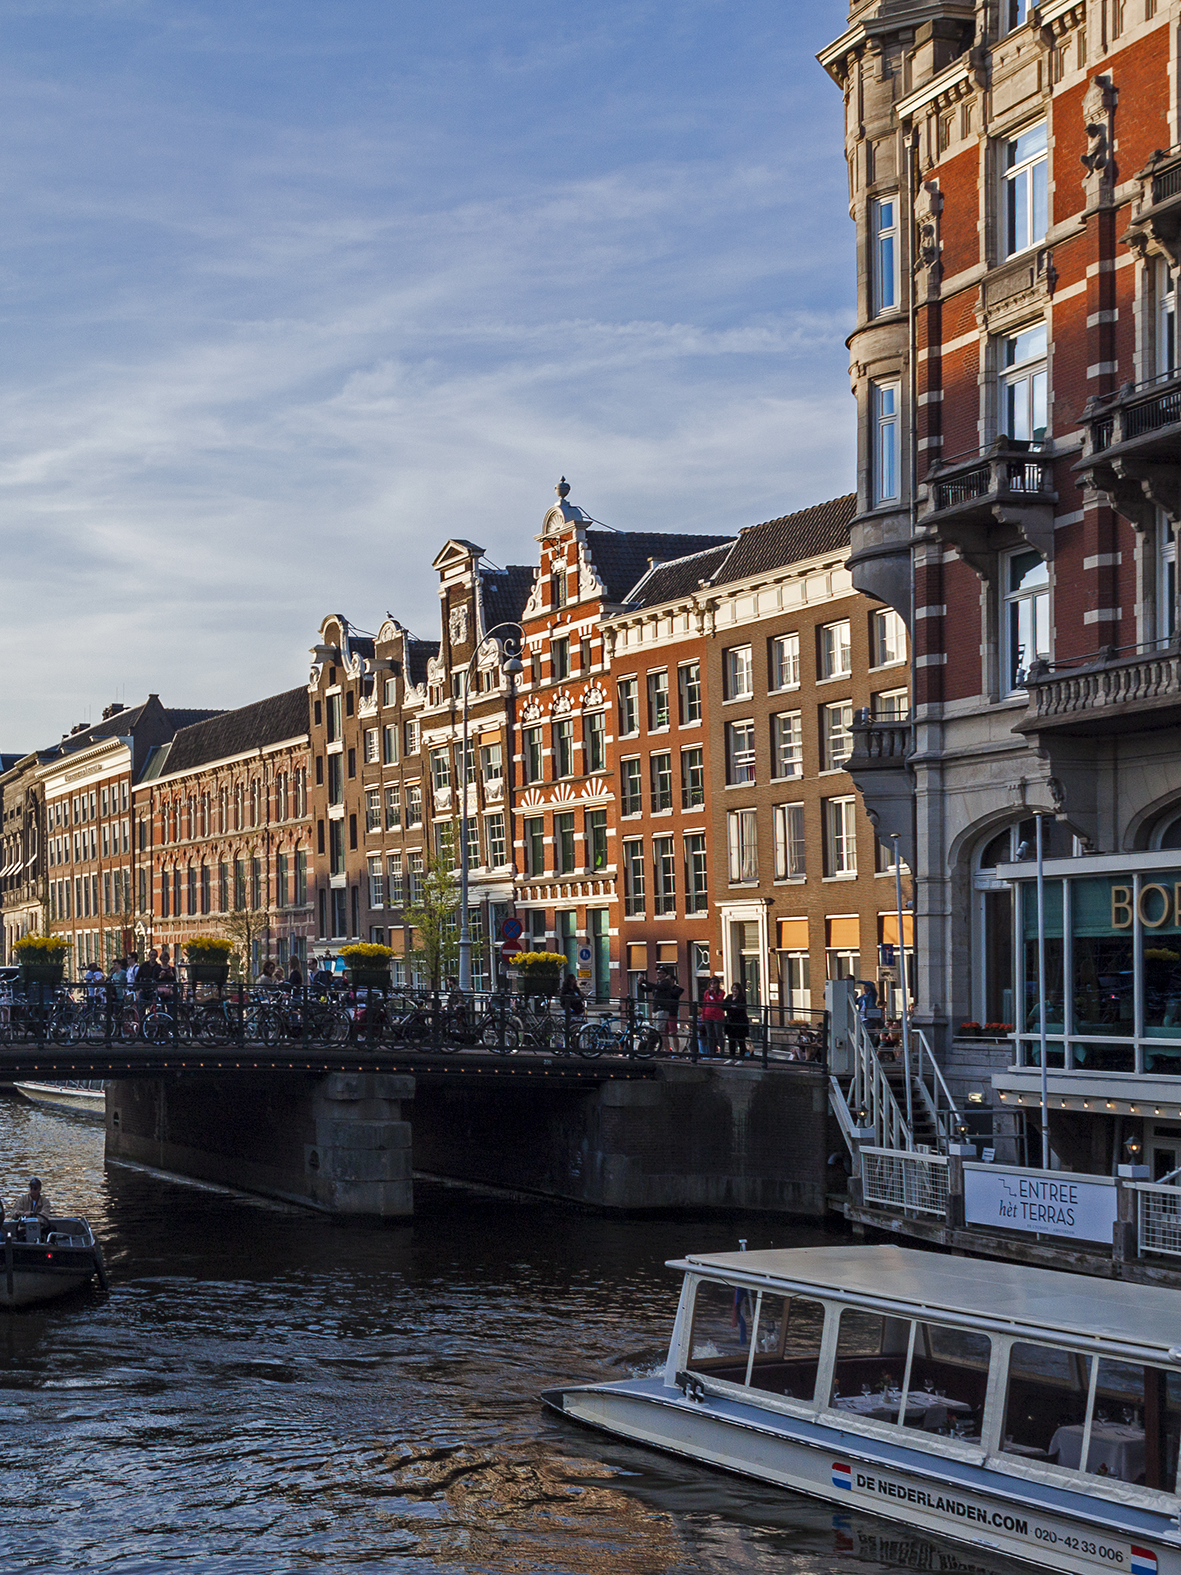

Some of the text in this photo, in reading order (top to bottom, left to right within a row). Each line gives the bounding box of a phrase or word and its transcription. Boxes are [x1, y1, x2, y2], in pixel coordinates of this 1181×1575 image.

[1019, 1179, 1078, 1205] ENTREE
[998, 1199, 1075, 1226] hèt TERRAS
[856, 1474, 876, 1491] DE
[877, 1479, 1028, 1536] NEDERLANDEN.COM
